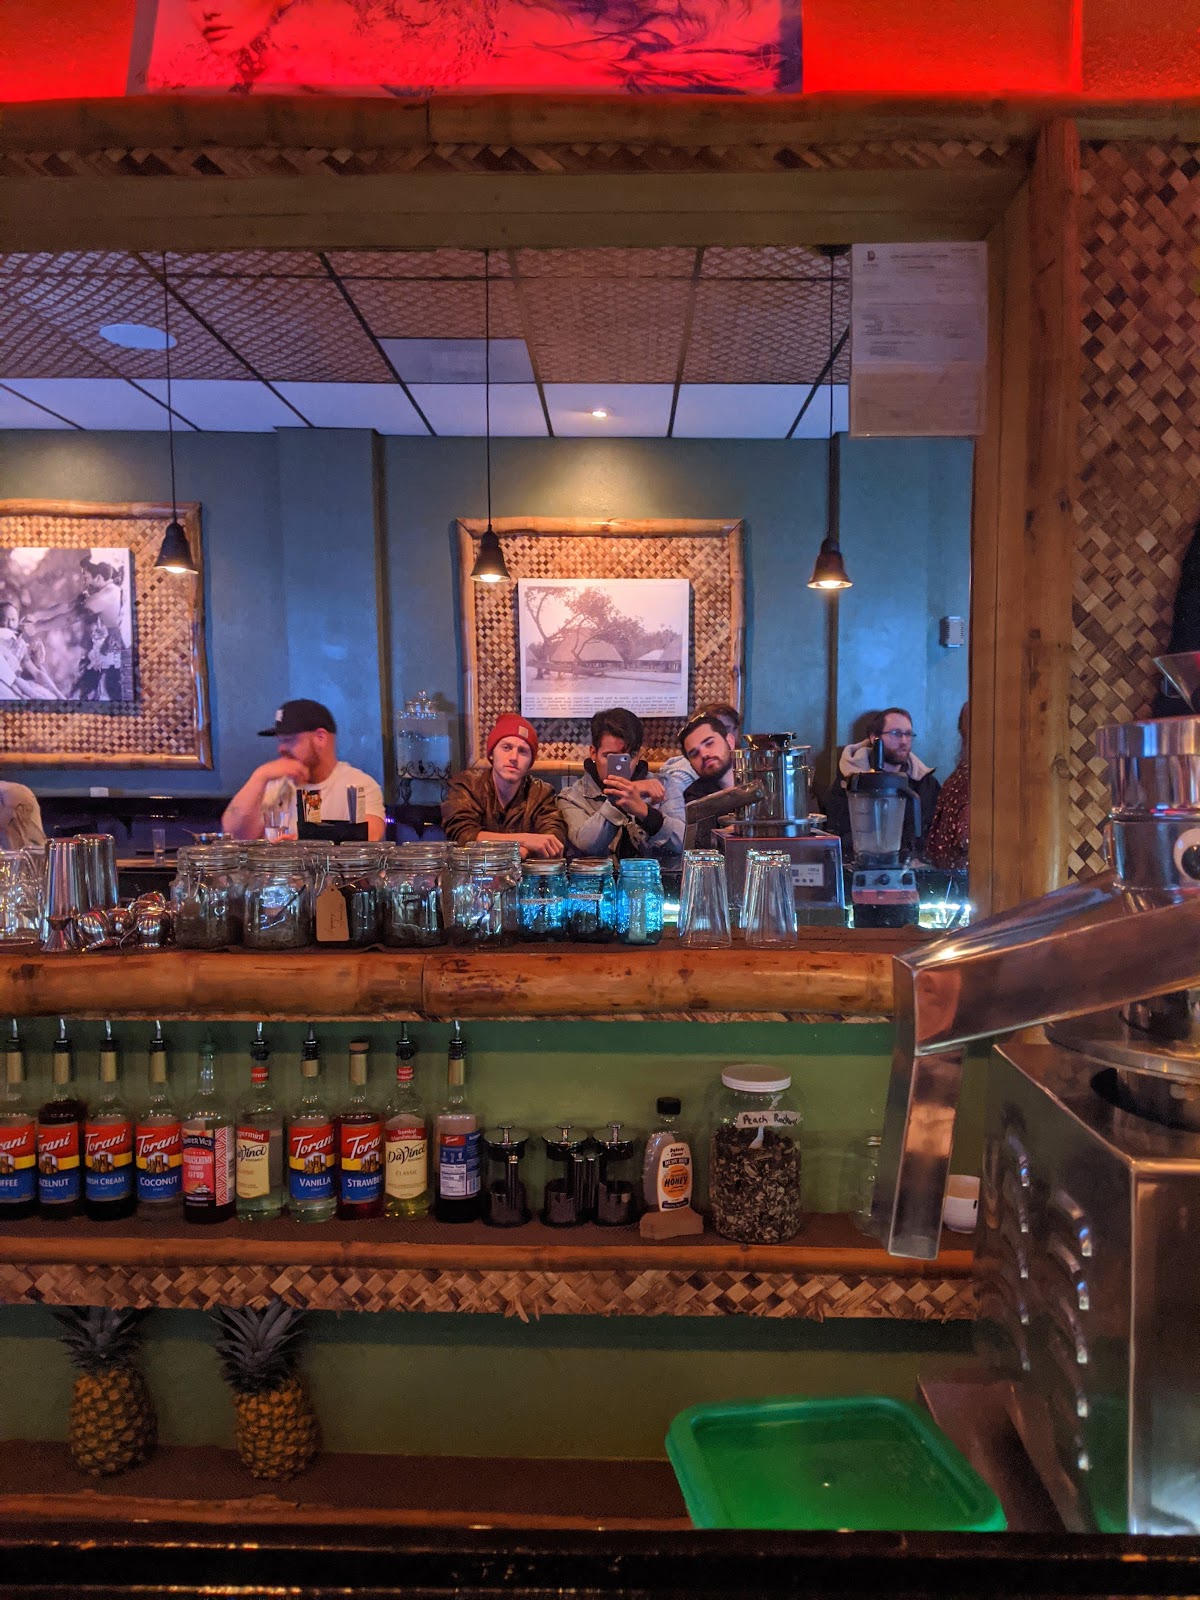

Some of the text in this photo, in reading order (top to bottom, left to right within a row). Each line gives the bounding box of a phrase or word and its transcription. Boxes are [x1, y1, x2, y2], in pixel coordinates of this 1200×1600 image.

[742, 1114, 768, 1125] Peach
[85, 1129, 126, 1157] Torani
[137, 1129, 180, 1158] Torani
[346, 1133, 383, 1160] Tora
[387, 1142, 425, 1164] DaVinci
[100, 1175, 125, 1186] CREAM
[139, 1175, 179, 1188] COCONUT
[299, 1176, 331, 1188] VANILLA
[664, 1177, 688, 1188] HONEY
